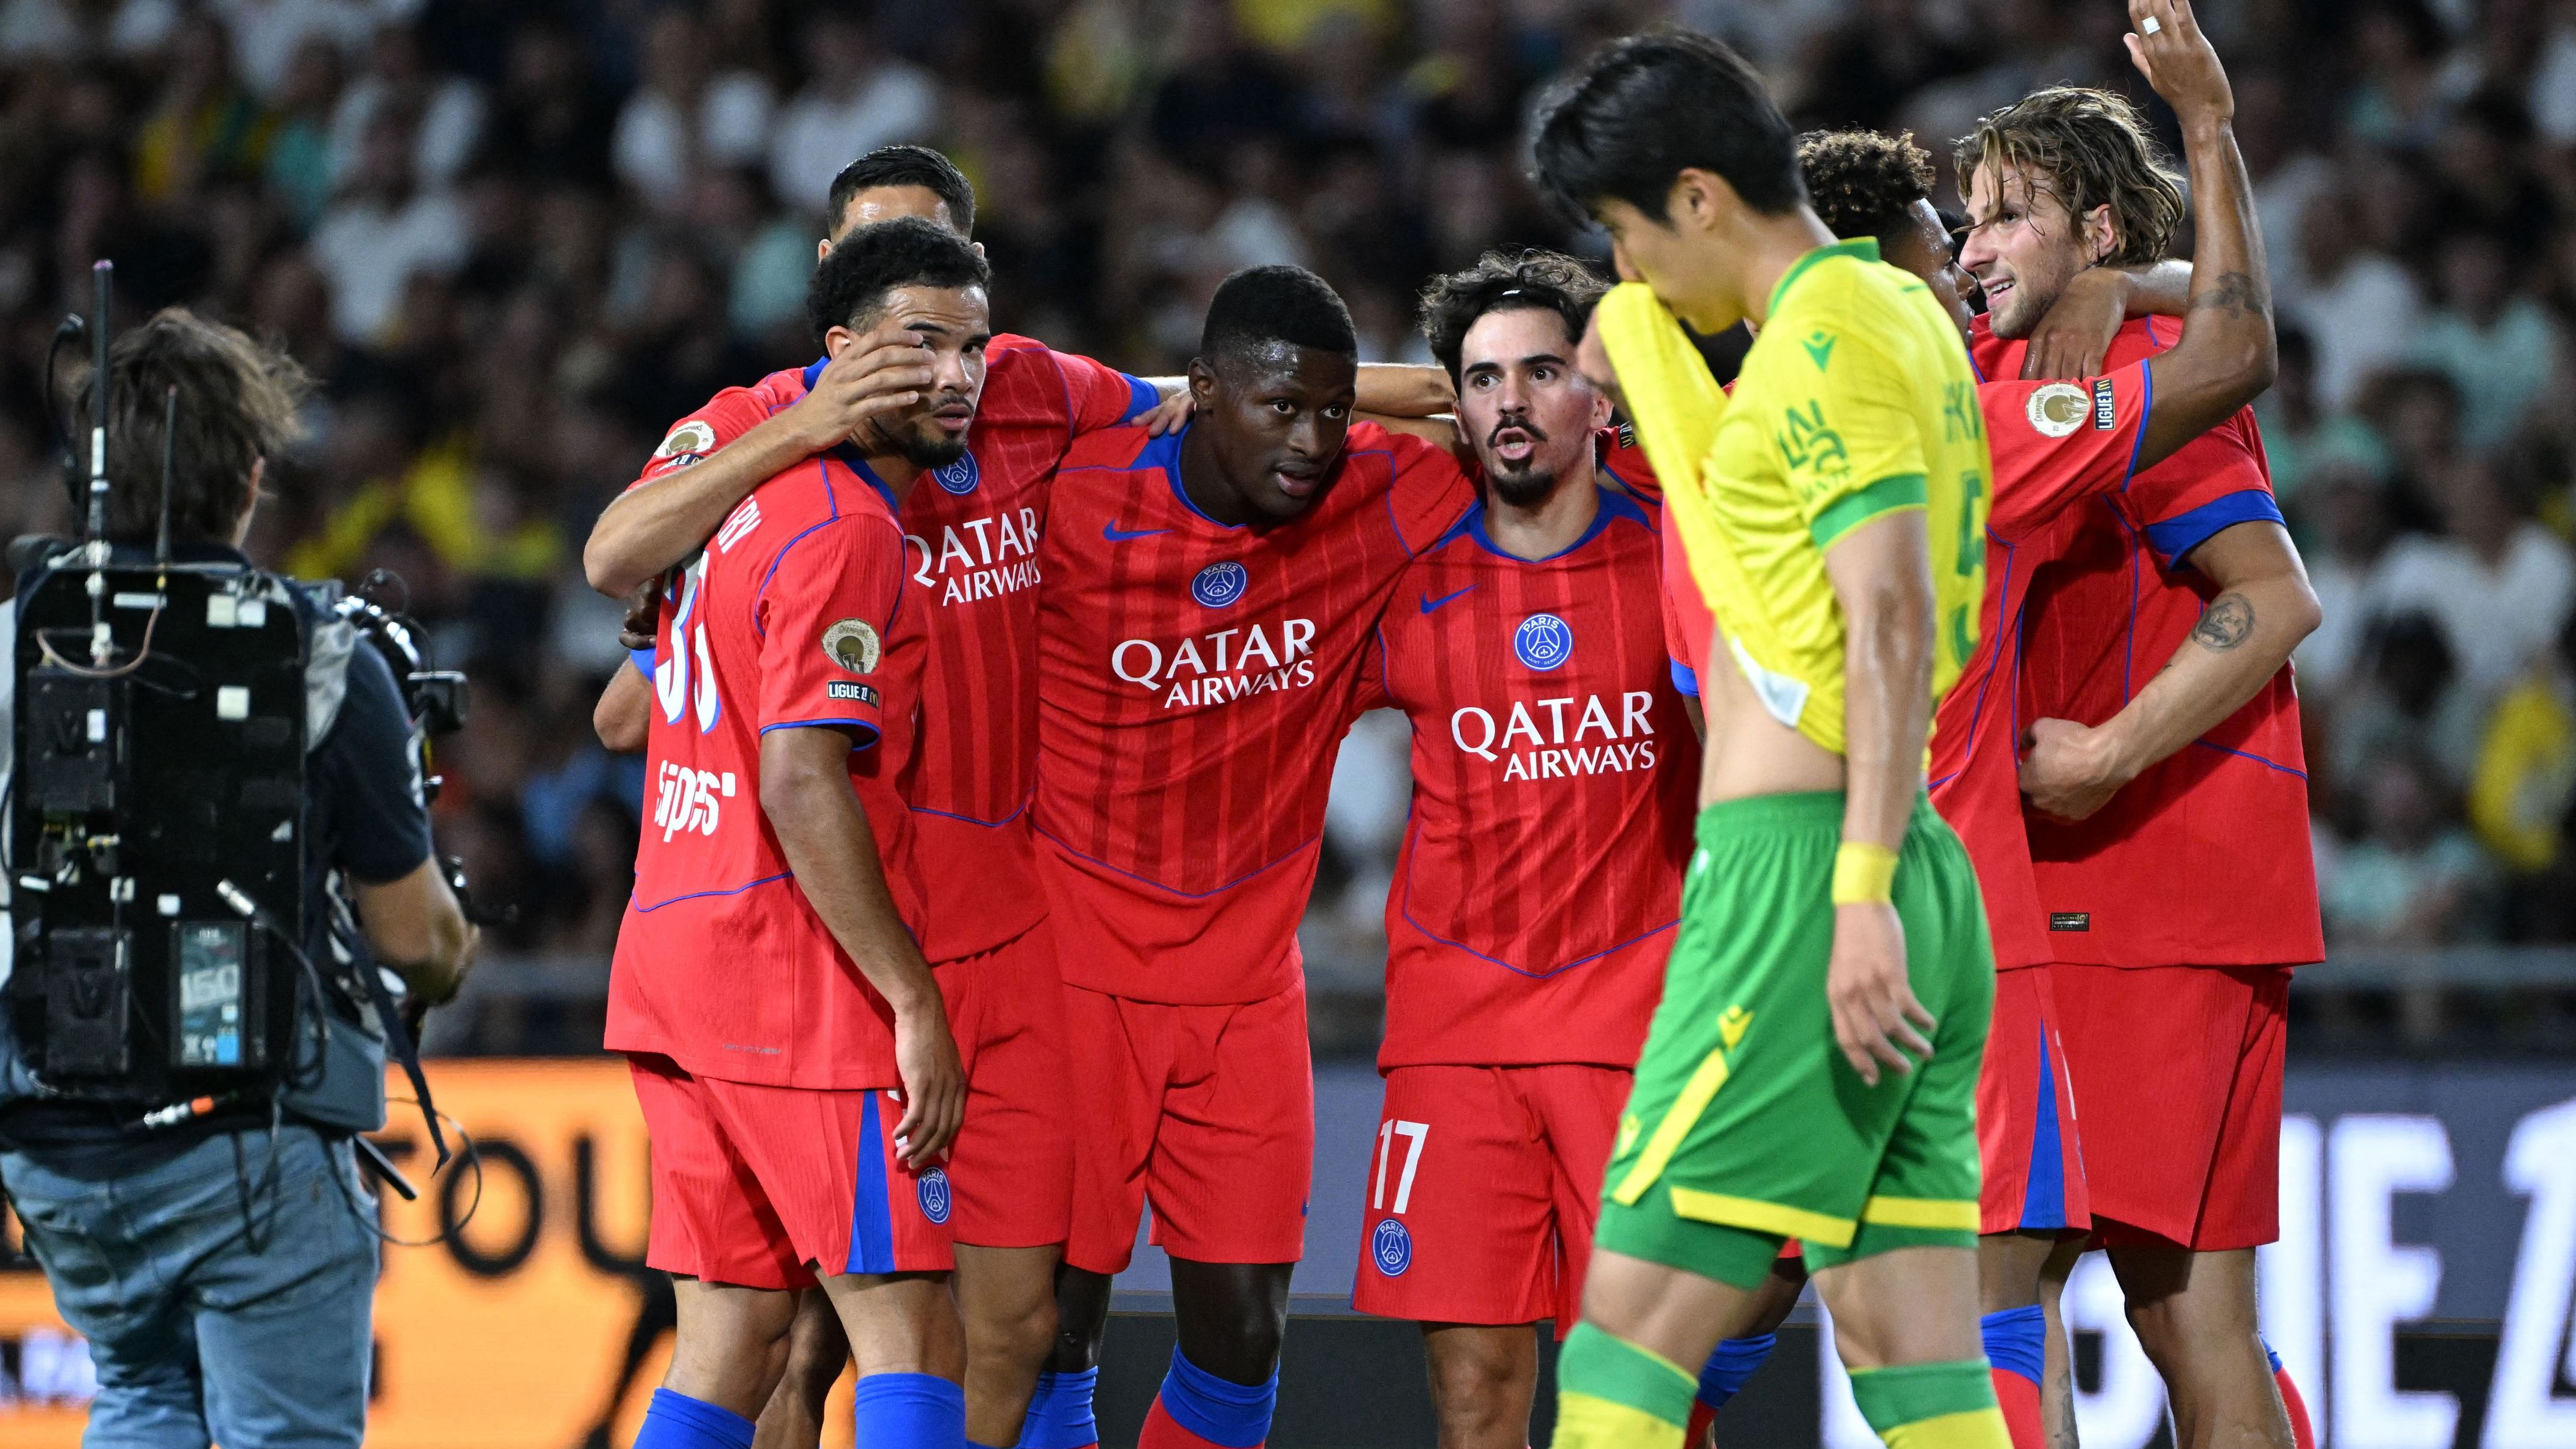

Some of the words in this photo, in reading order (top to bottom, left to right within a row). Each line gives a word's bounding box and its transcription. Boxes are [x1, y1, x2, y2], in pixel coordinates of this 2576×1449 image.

[2098, 397, 2113, 429] LIGUE
[717, 494, 761, 554] RY
[905, 507, 1038, 588] QATAR
[1203, 564, 1239, 576] PARIS
[942, 557, 1041, 607] AIRWAYS
[1522, 617, 1560, 633] PARIS
[1112, 618, 1316, 691] QATAR
[828, 684, 860, 699] LIGUE
[1164, 660, 1315, 709] AIRWAYS
[1451, 690, 1655, 763] QATAR
[1502, 740, 1656, 782] AIRWAYS
[922, 1170, 944, 1183] PARIS
[1374, 1119, 1430, 1214] 17
[1379, 1223, 1405, 1238] PARIS
